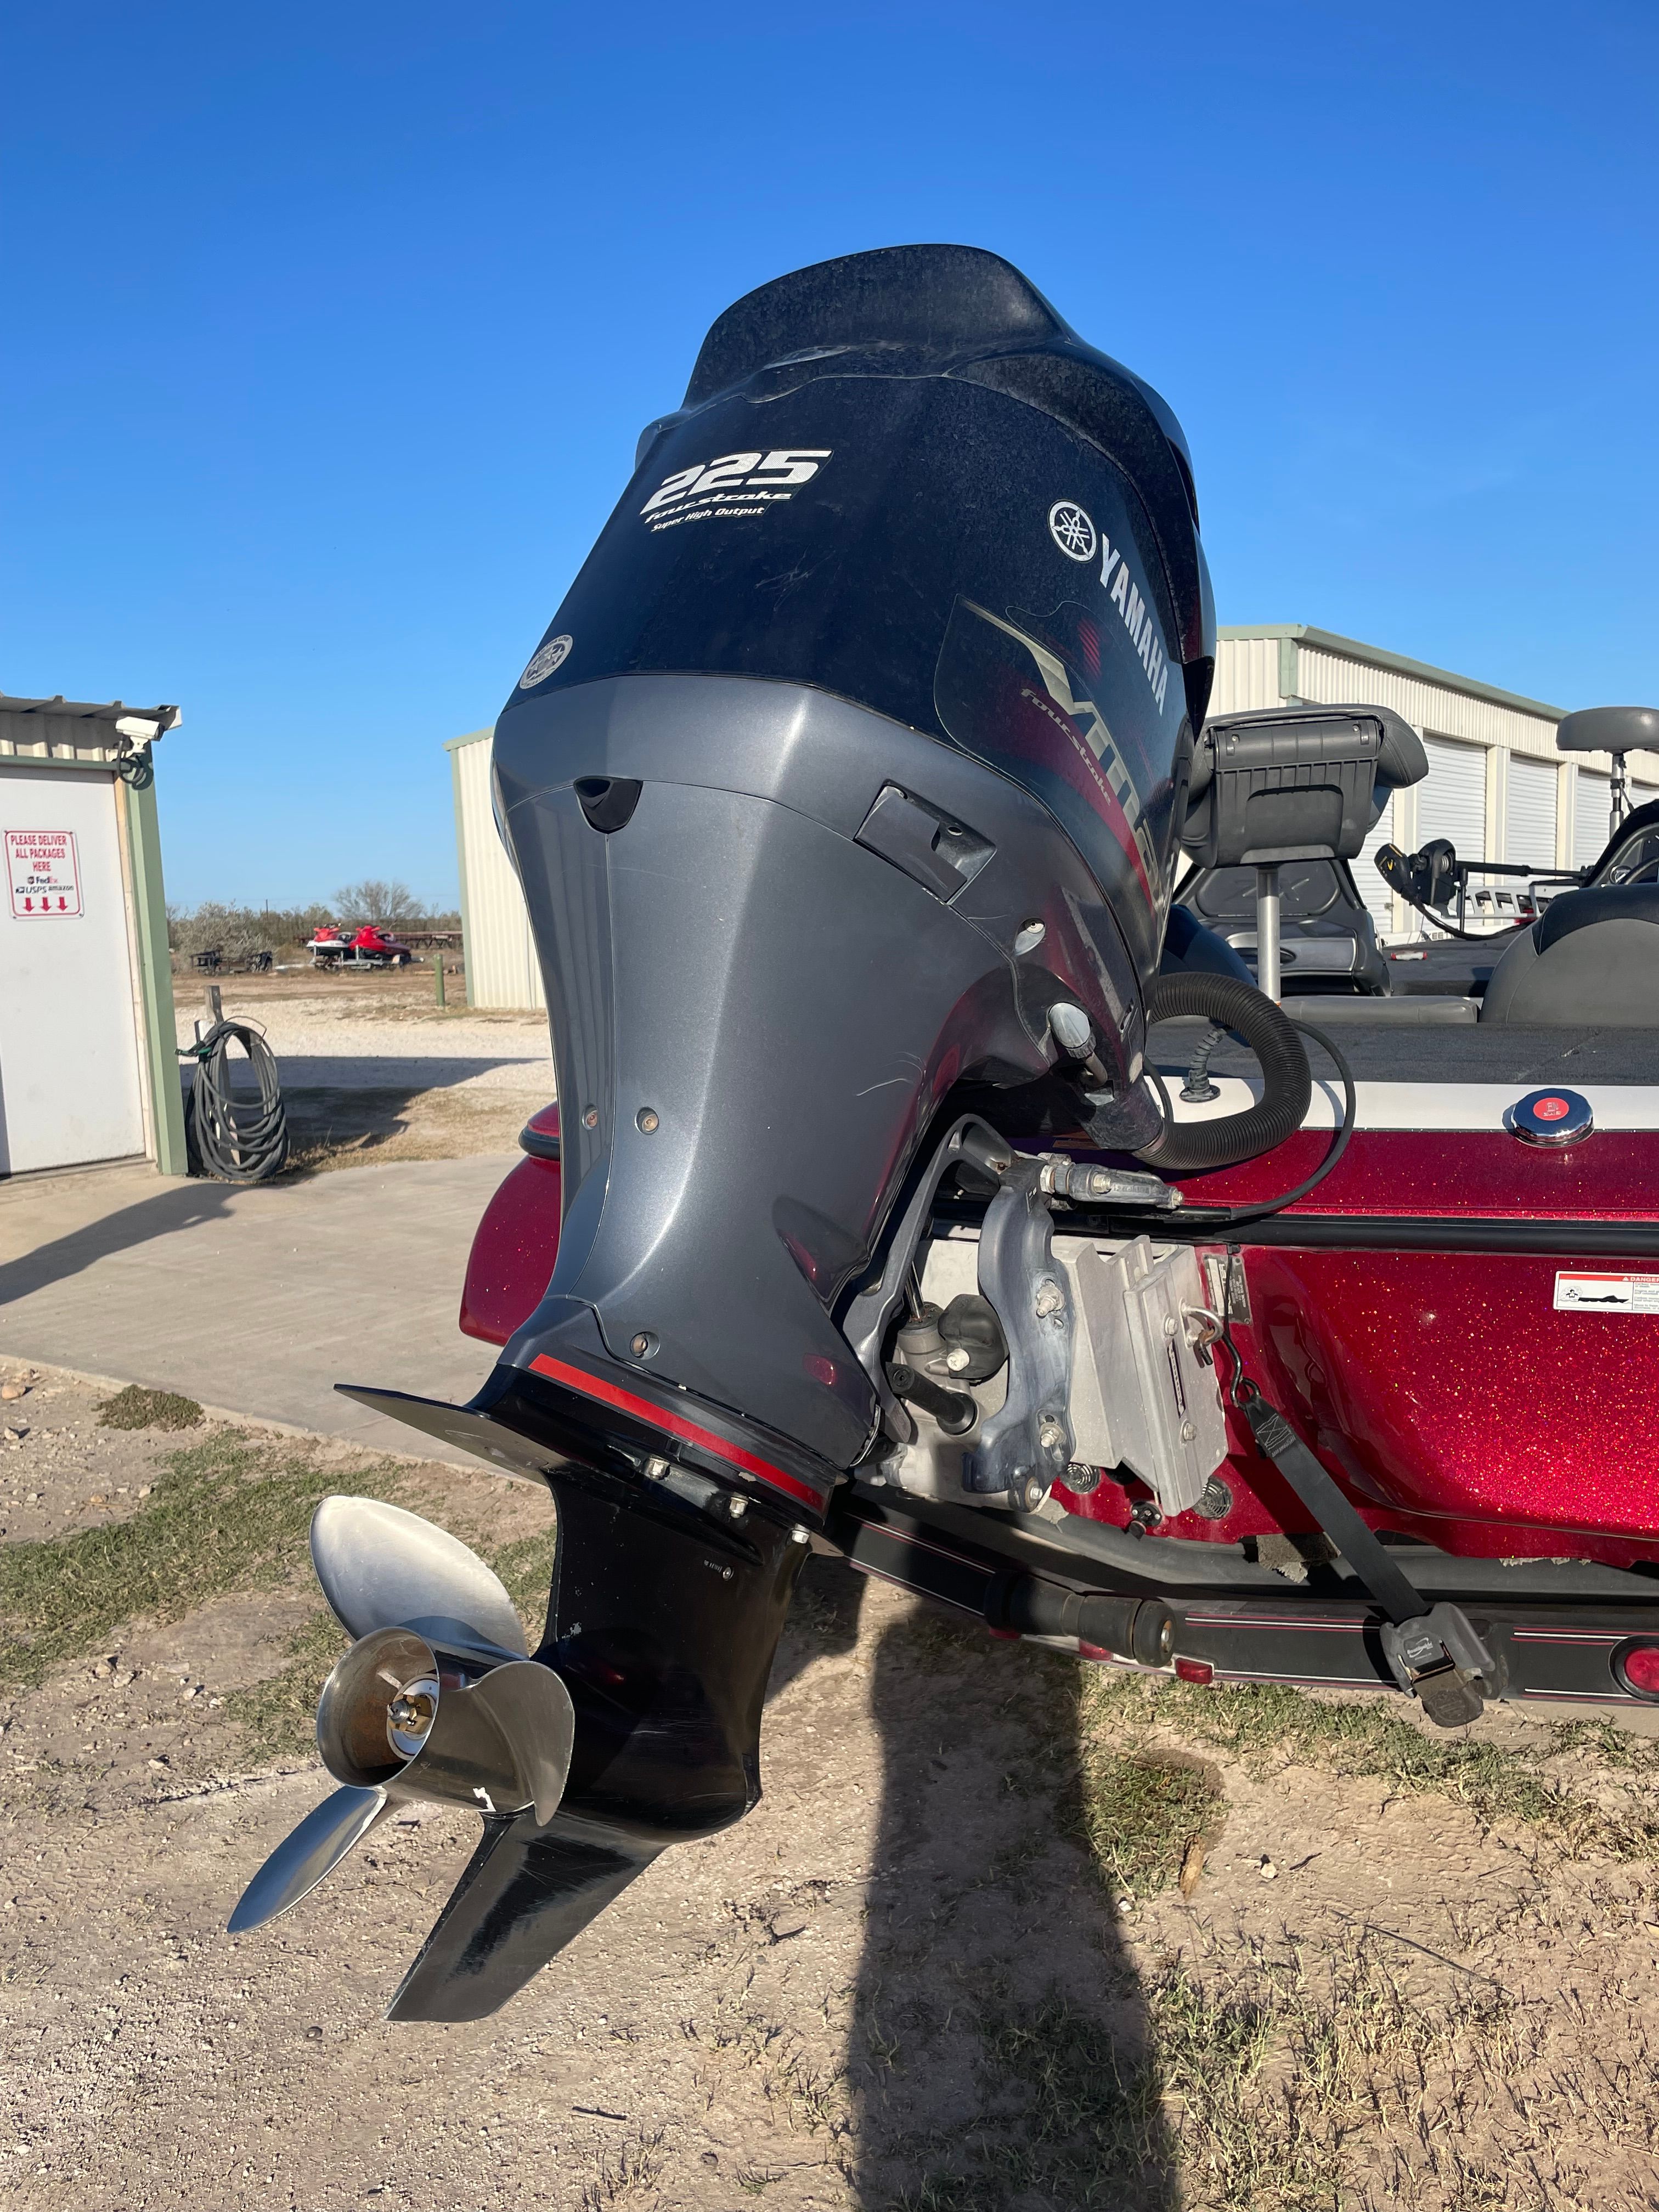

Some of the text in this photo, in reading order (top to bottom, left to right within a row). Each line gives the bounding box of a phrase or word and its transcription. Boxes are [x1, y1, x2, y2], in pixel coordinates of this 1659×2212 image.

[640, 450, 832, 515] 225
[651, 507, 765, 532] Super High Output
[1099, 533, 1169, 716] YAMAHA
[11, 835, 67, 846] PLEASE DELIVER
[15, 848, 65, 859] ALL PACKAGES
[33, 861, 51, 872] HERE
[26, 886, 47, 894] USPS
